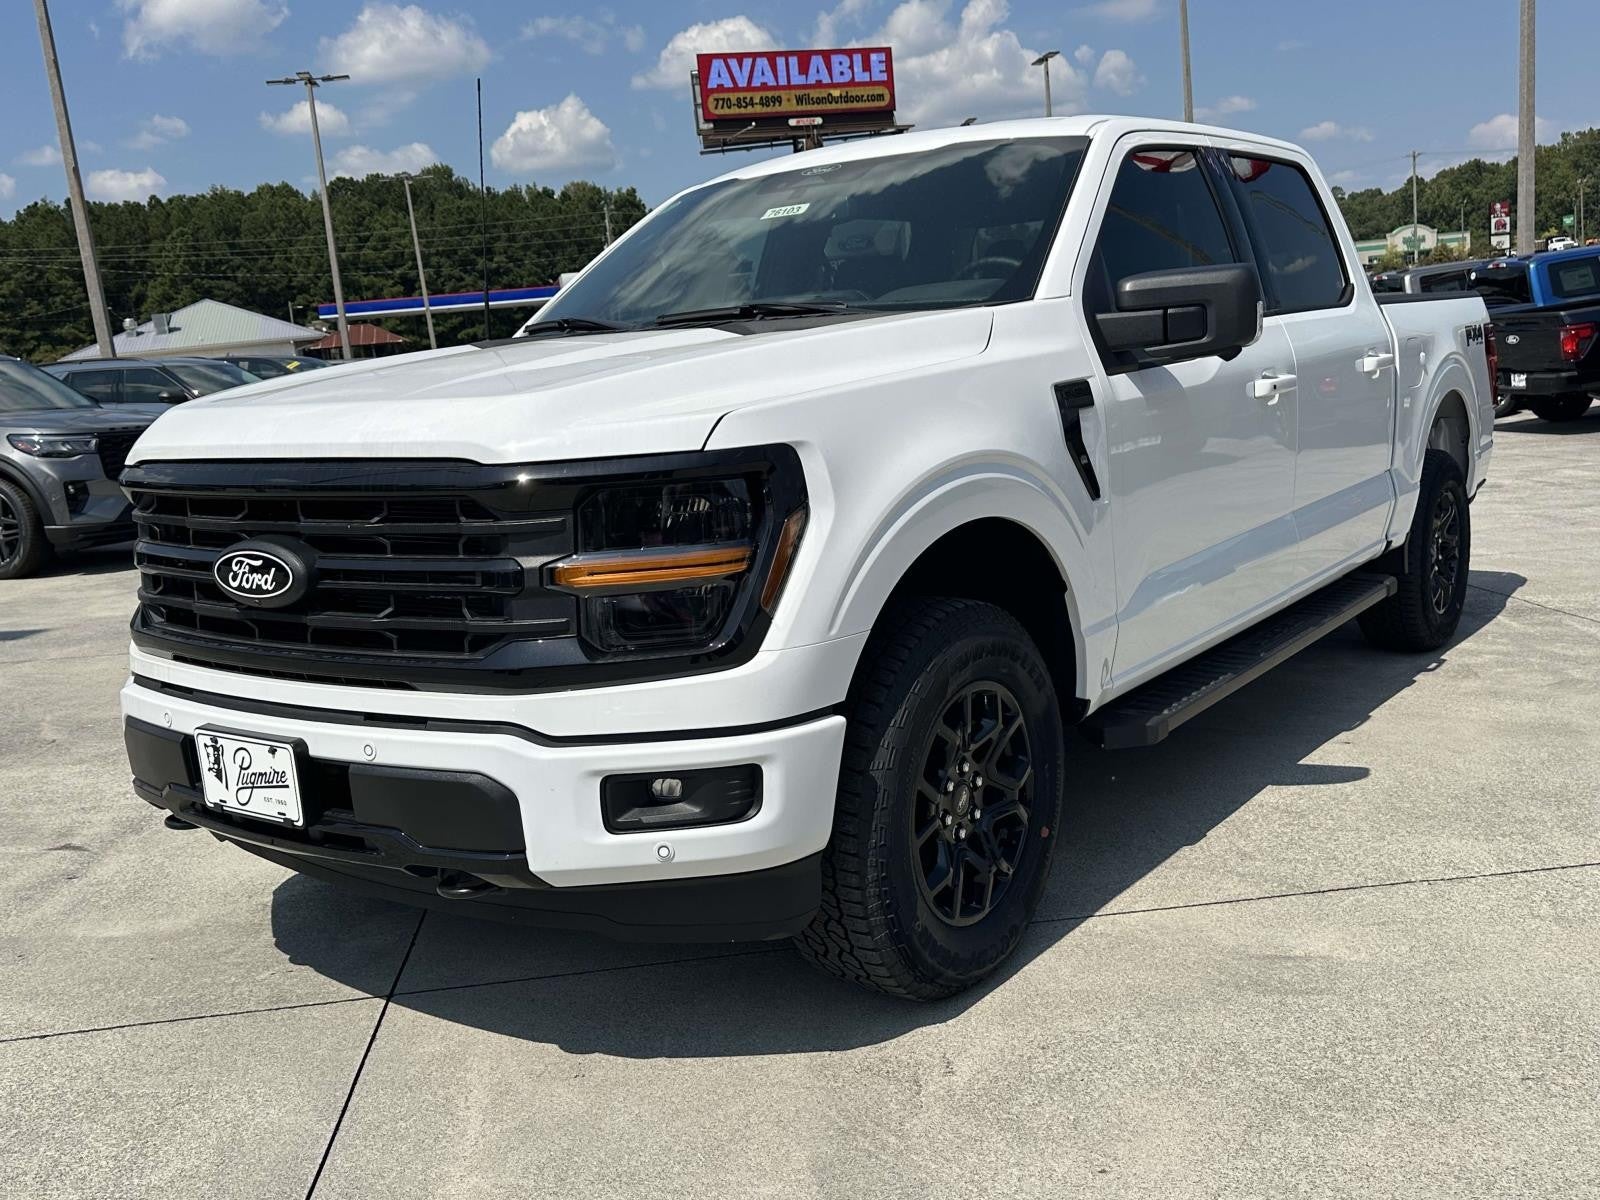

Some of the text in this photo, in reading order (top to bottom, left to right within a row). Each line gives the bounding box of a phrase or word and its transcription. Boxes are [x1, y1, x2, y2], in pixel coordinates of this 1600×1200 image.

[707, 52, 887, 88] AVAILABLE
[713, 91, 885, 110] 770-854-4899 WilsonOutdoor.com
[768, 206, 802, 217] 76103
[228, 556, 276, 590] Ford
[233, 747, 289, 806] Pugmire
